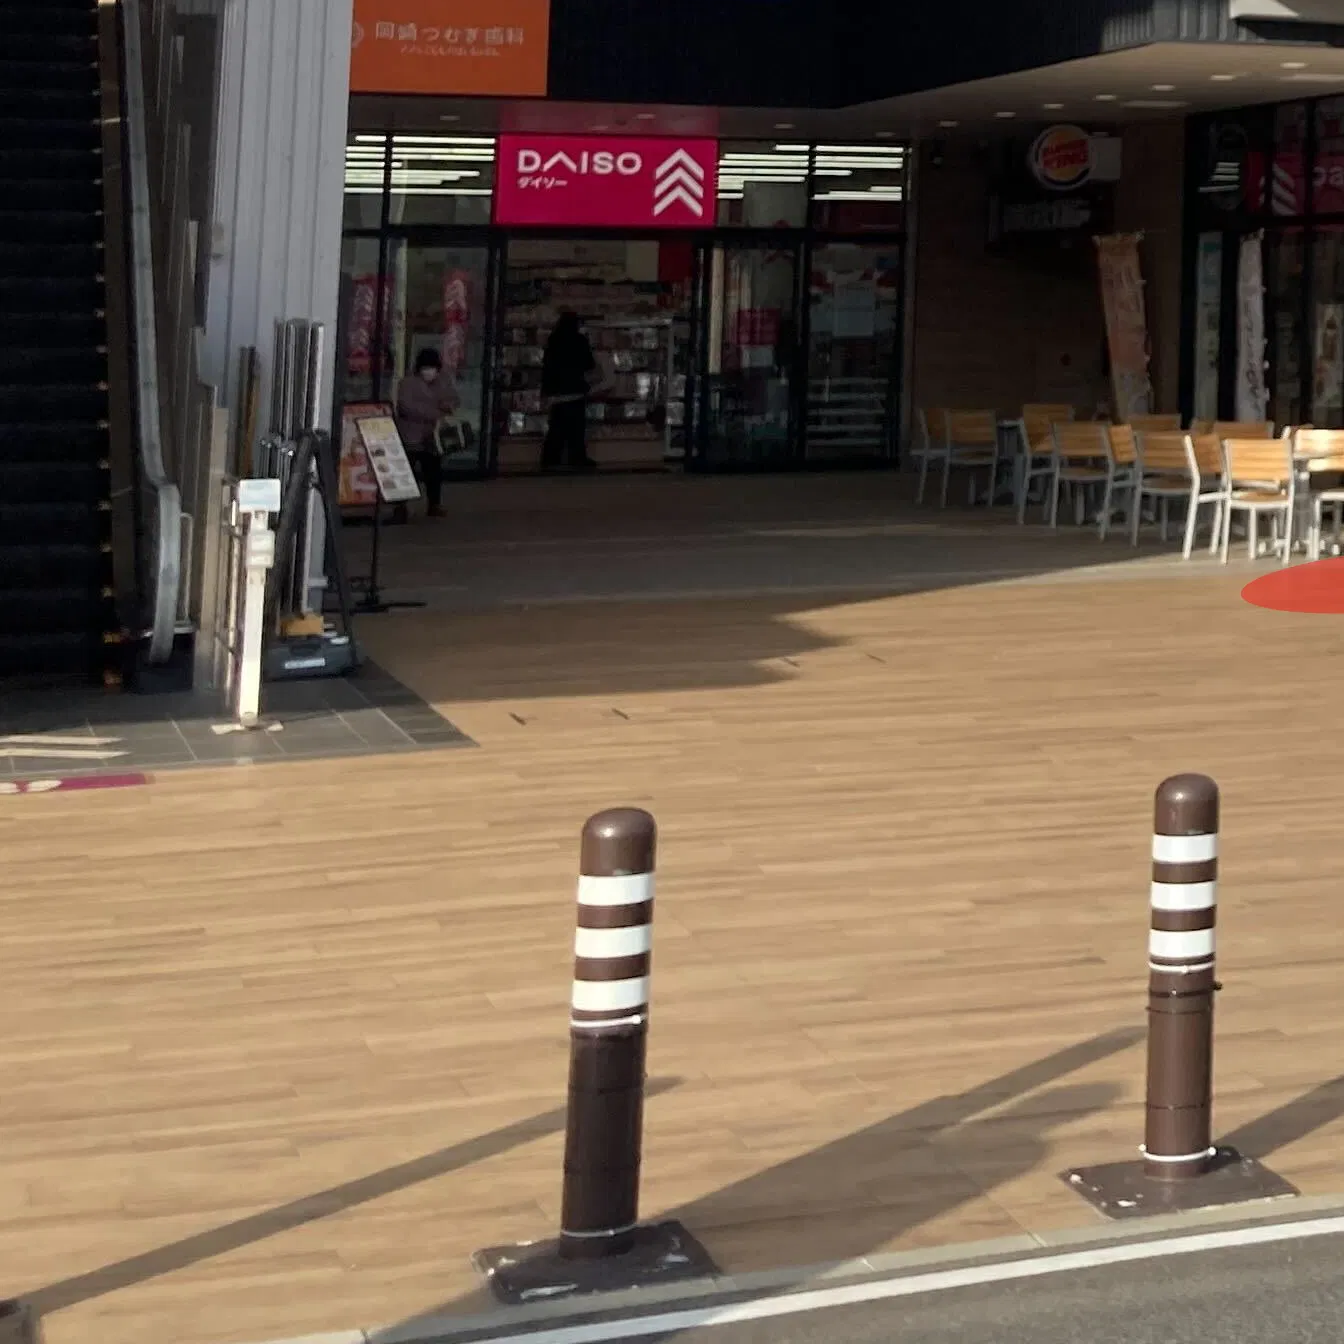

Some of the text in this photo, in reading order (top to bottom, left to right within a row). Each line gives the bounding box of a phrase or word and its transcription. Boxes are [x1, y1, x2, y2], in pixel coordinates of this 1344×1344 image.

[517, 149, 642, 175] DAISO
[517, 175, 568, 191] ダイソー
